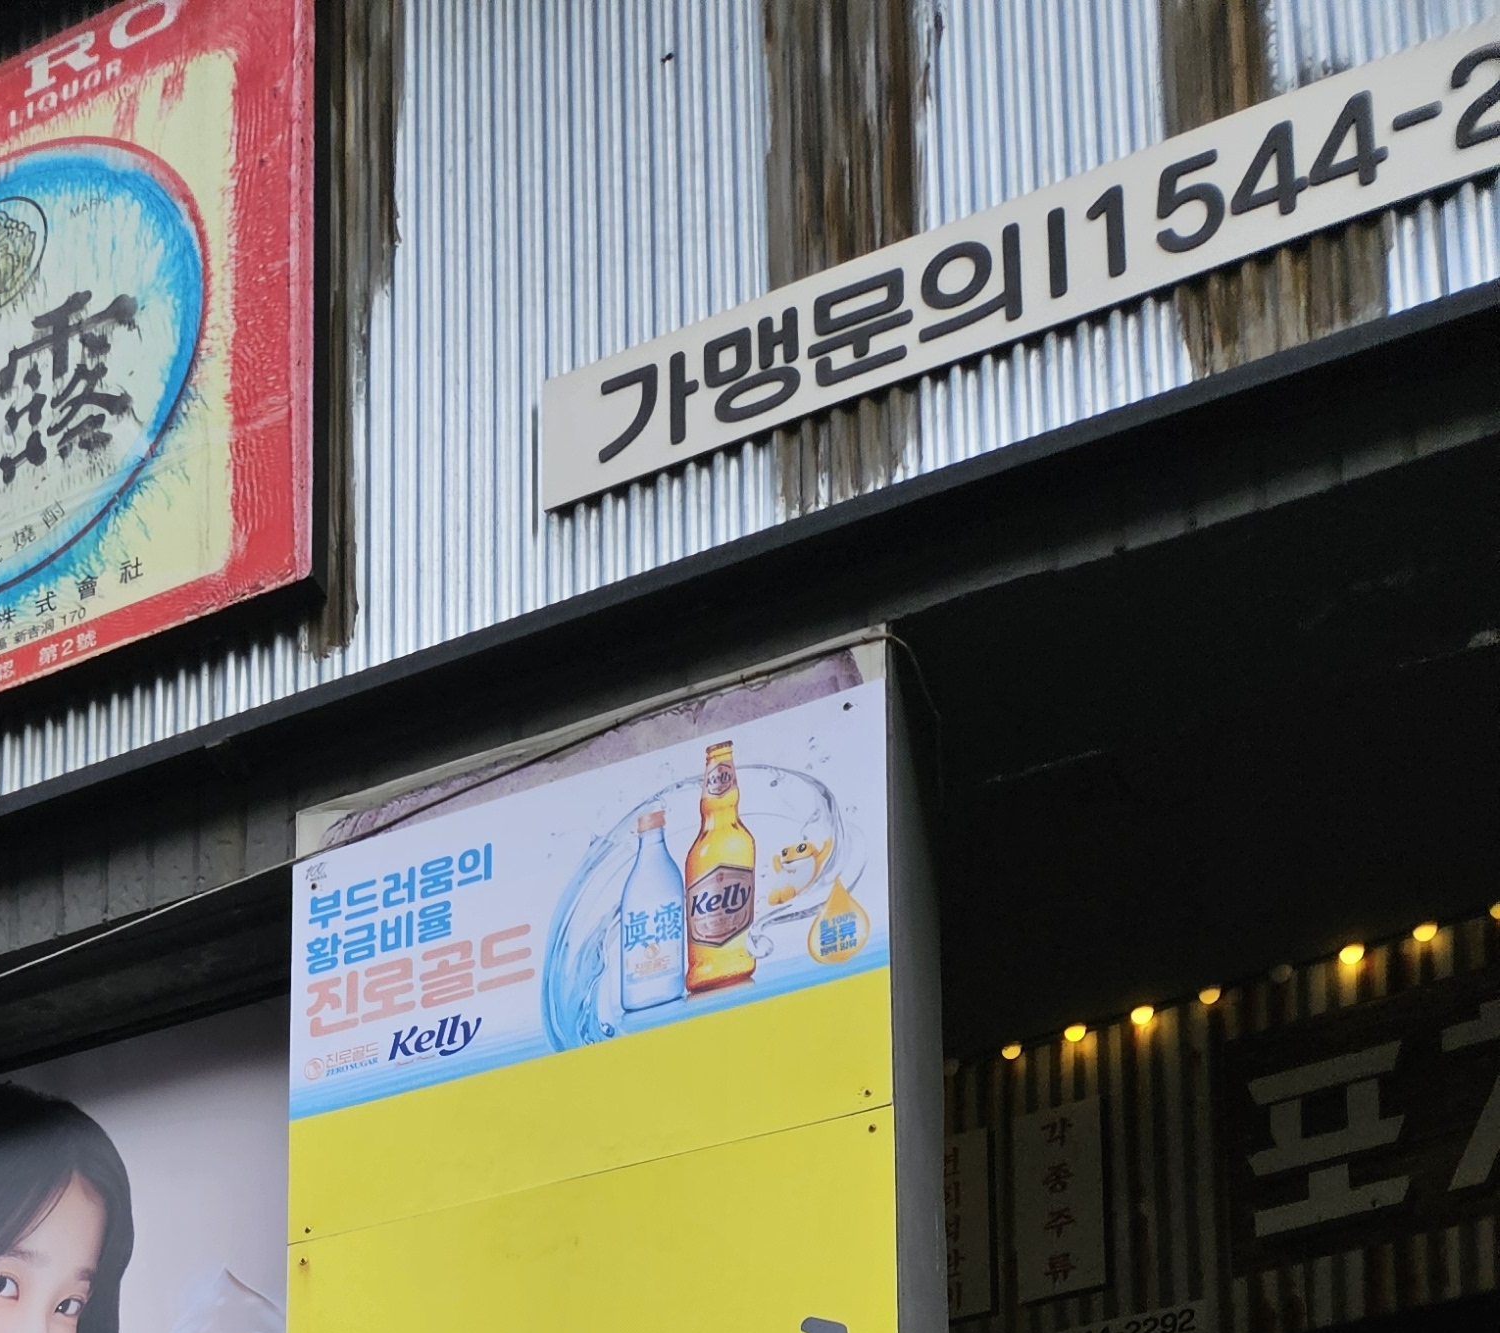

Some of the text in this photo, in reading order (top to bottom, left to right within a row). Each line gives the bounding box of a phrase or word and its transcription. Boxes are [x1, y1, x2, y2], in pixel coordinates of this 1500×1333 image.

[9, 58, 123, 128] LIQUOR
[62, 606, 87, 627] 170
[308, 842, 492, 929] 부드러움의
[690, 882, 752, 918] Kelly
[306, 900, 453, 975] 황금비율
[306, 924, 536, 1038] 진로골드
[388, 1013, 482, 1061] Kelly
